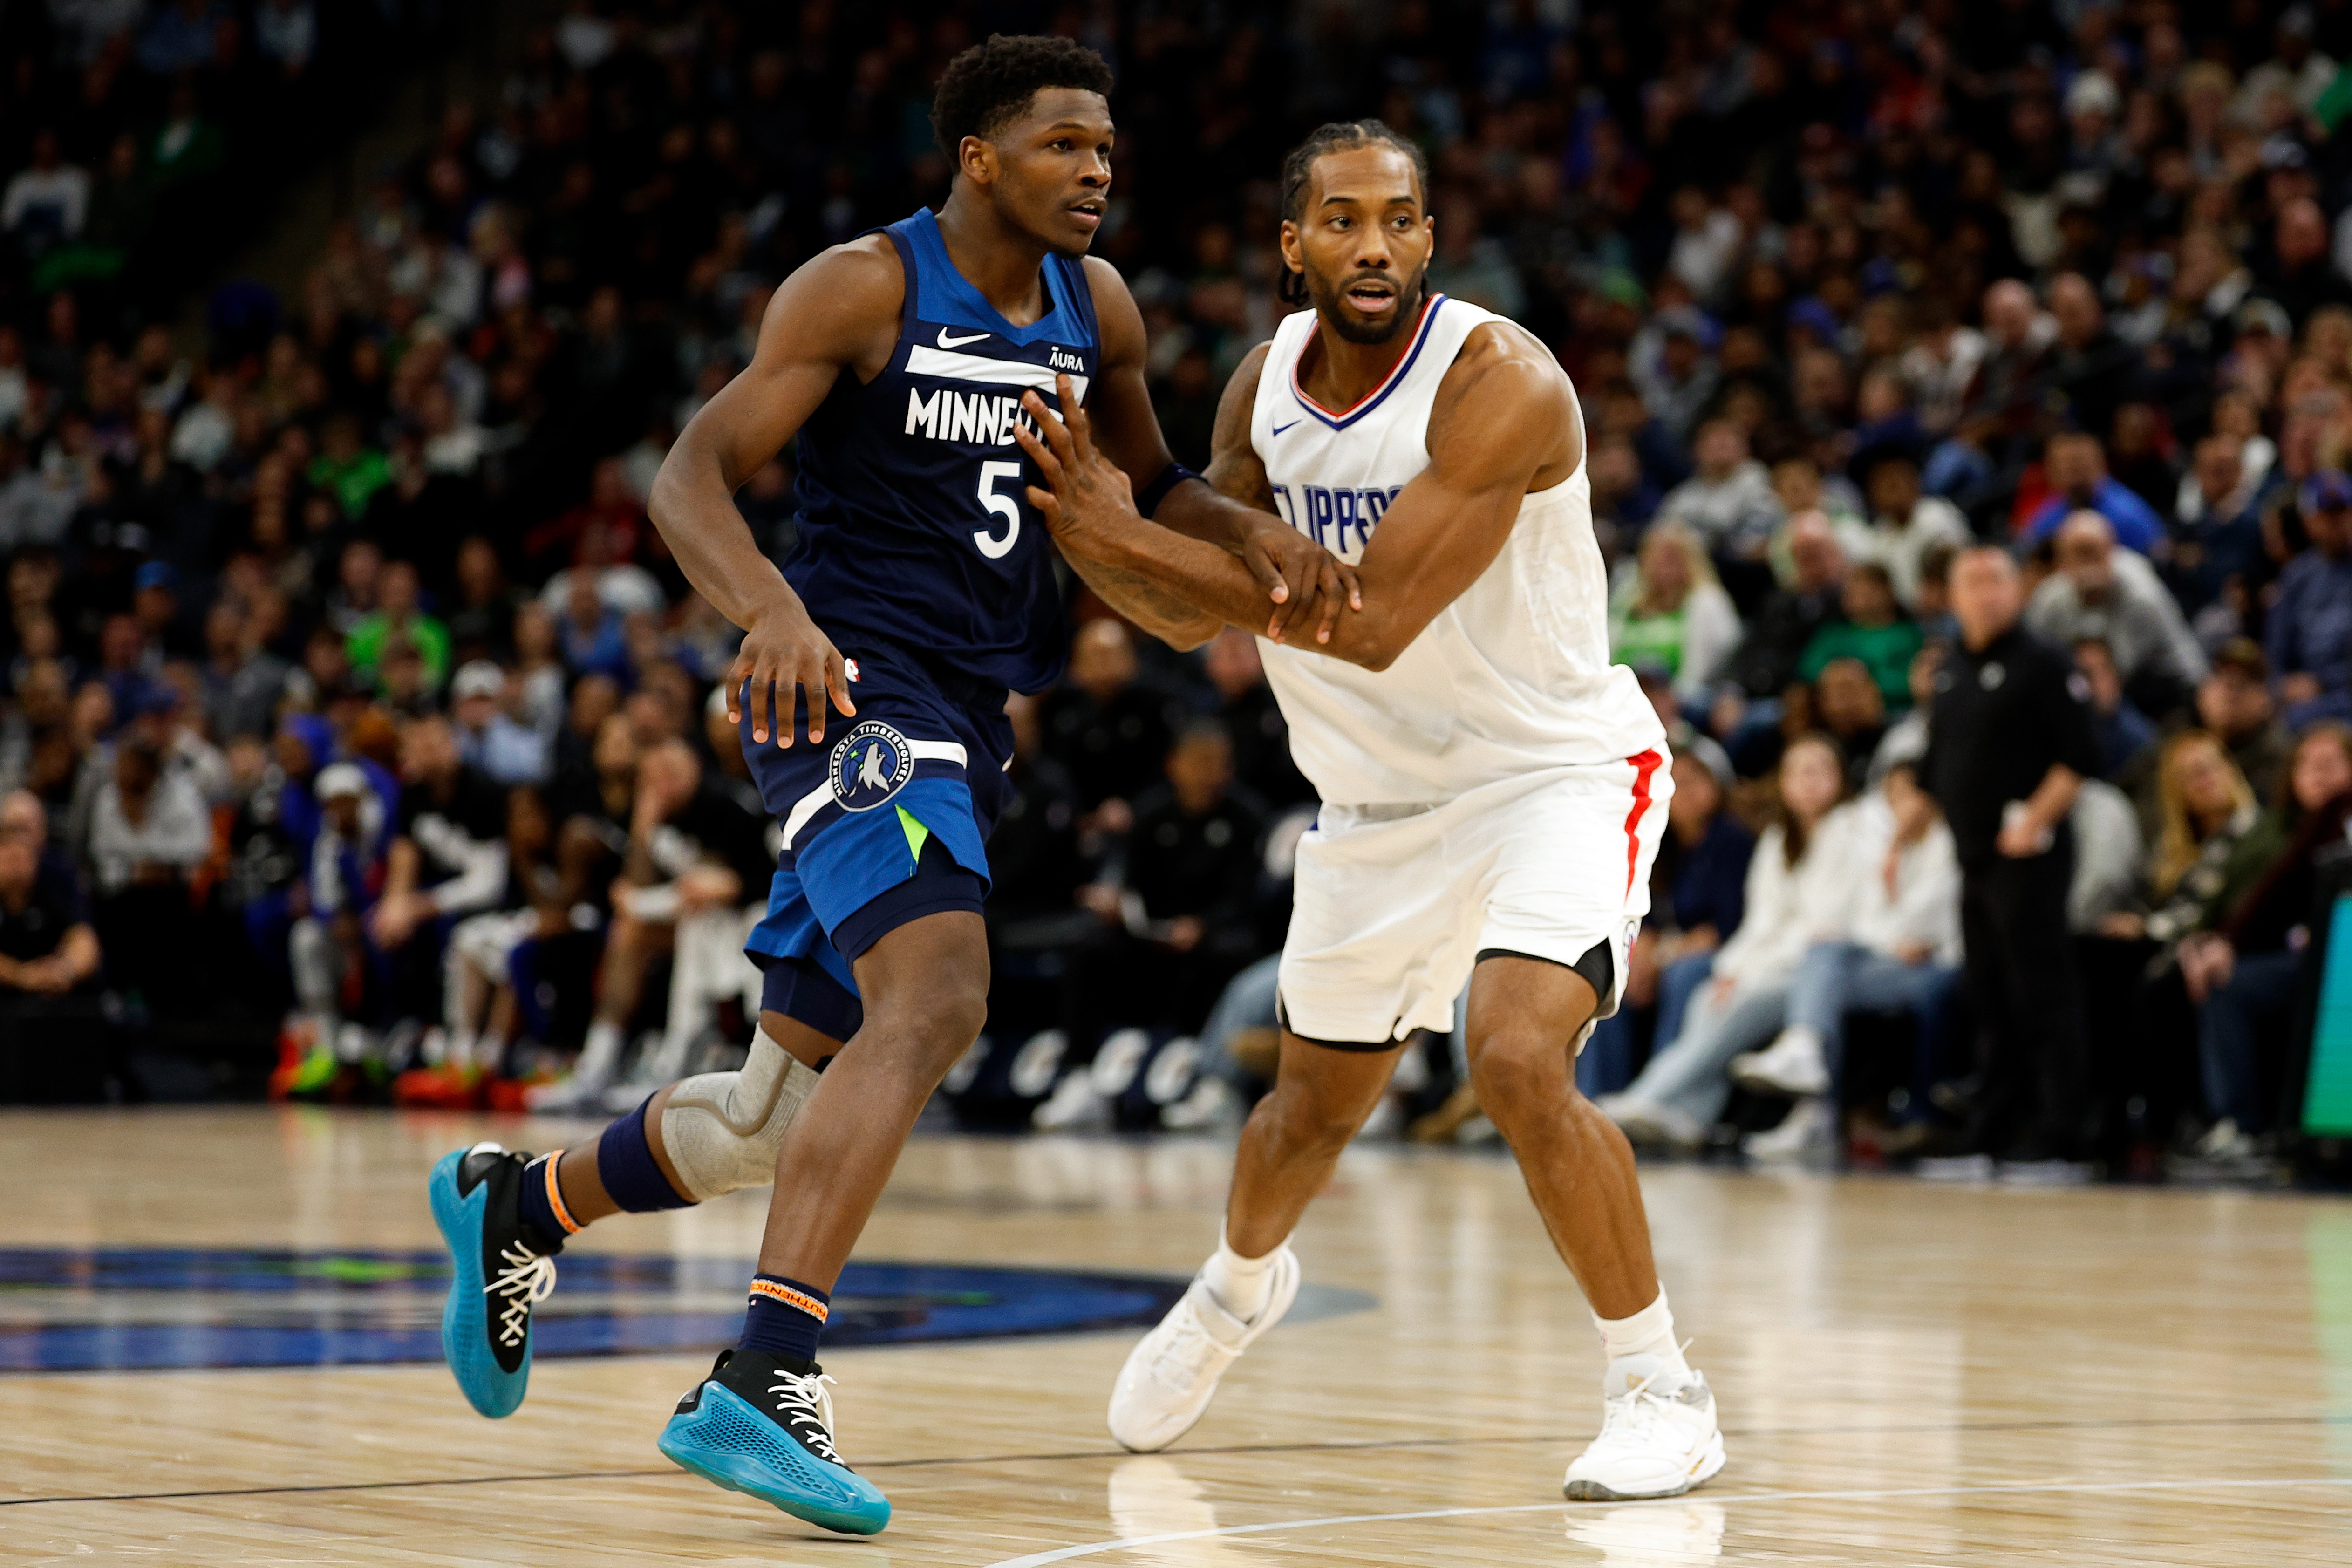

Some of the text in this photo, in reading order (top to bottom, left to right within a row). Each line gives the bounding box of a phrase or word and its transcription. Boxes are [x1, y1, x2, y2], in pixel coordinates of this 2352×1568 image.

[973, 460, 1021, 559] 5
[832, 725, 910, 797] MINNESOTA TIMBERWOLVES
